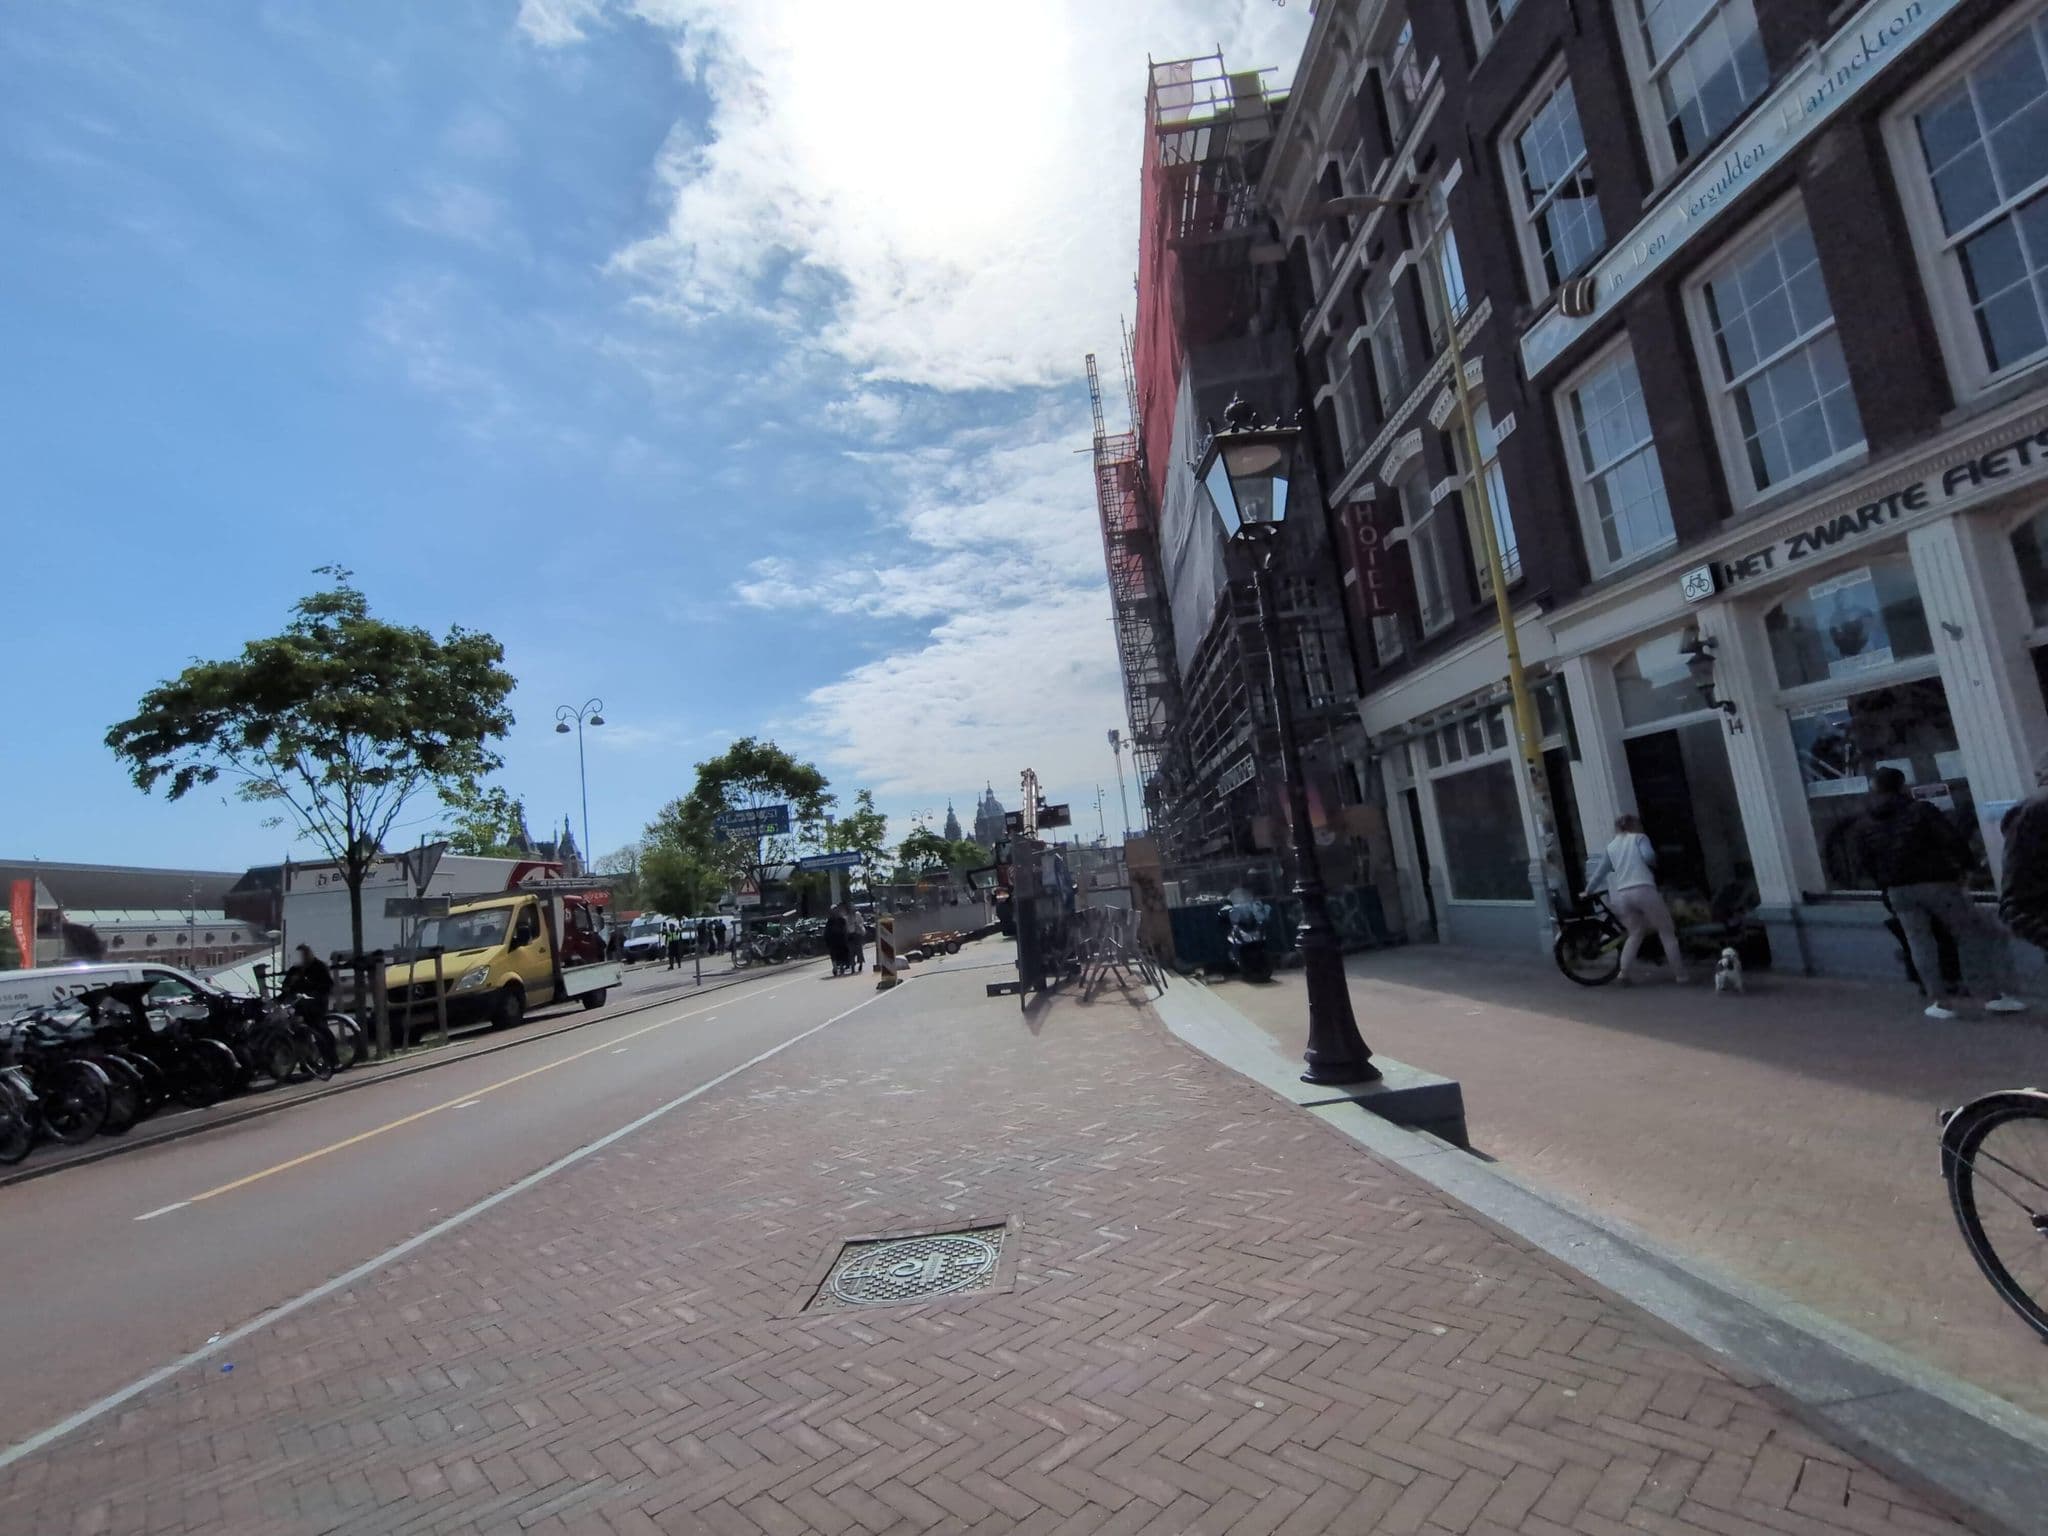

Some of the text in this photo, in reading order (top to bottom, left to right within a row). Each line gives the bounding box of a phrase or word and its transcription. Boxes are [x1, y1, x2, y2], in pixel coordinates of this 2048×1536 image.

[1608, 270, 1624, 291] In
[1632, 232, 1667, 266] Den
[1678, 143, 1766, 223] Vergulden
[1354, 502, 1385, 610] HOTEL
[1724, 546, 1776, 583] HET
[1784, 482, 1929, 561] ZWARTE
[1727, 718, 1744, 735] 14
